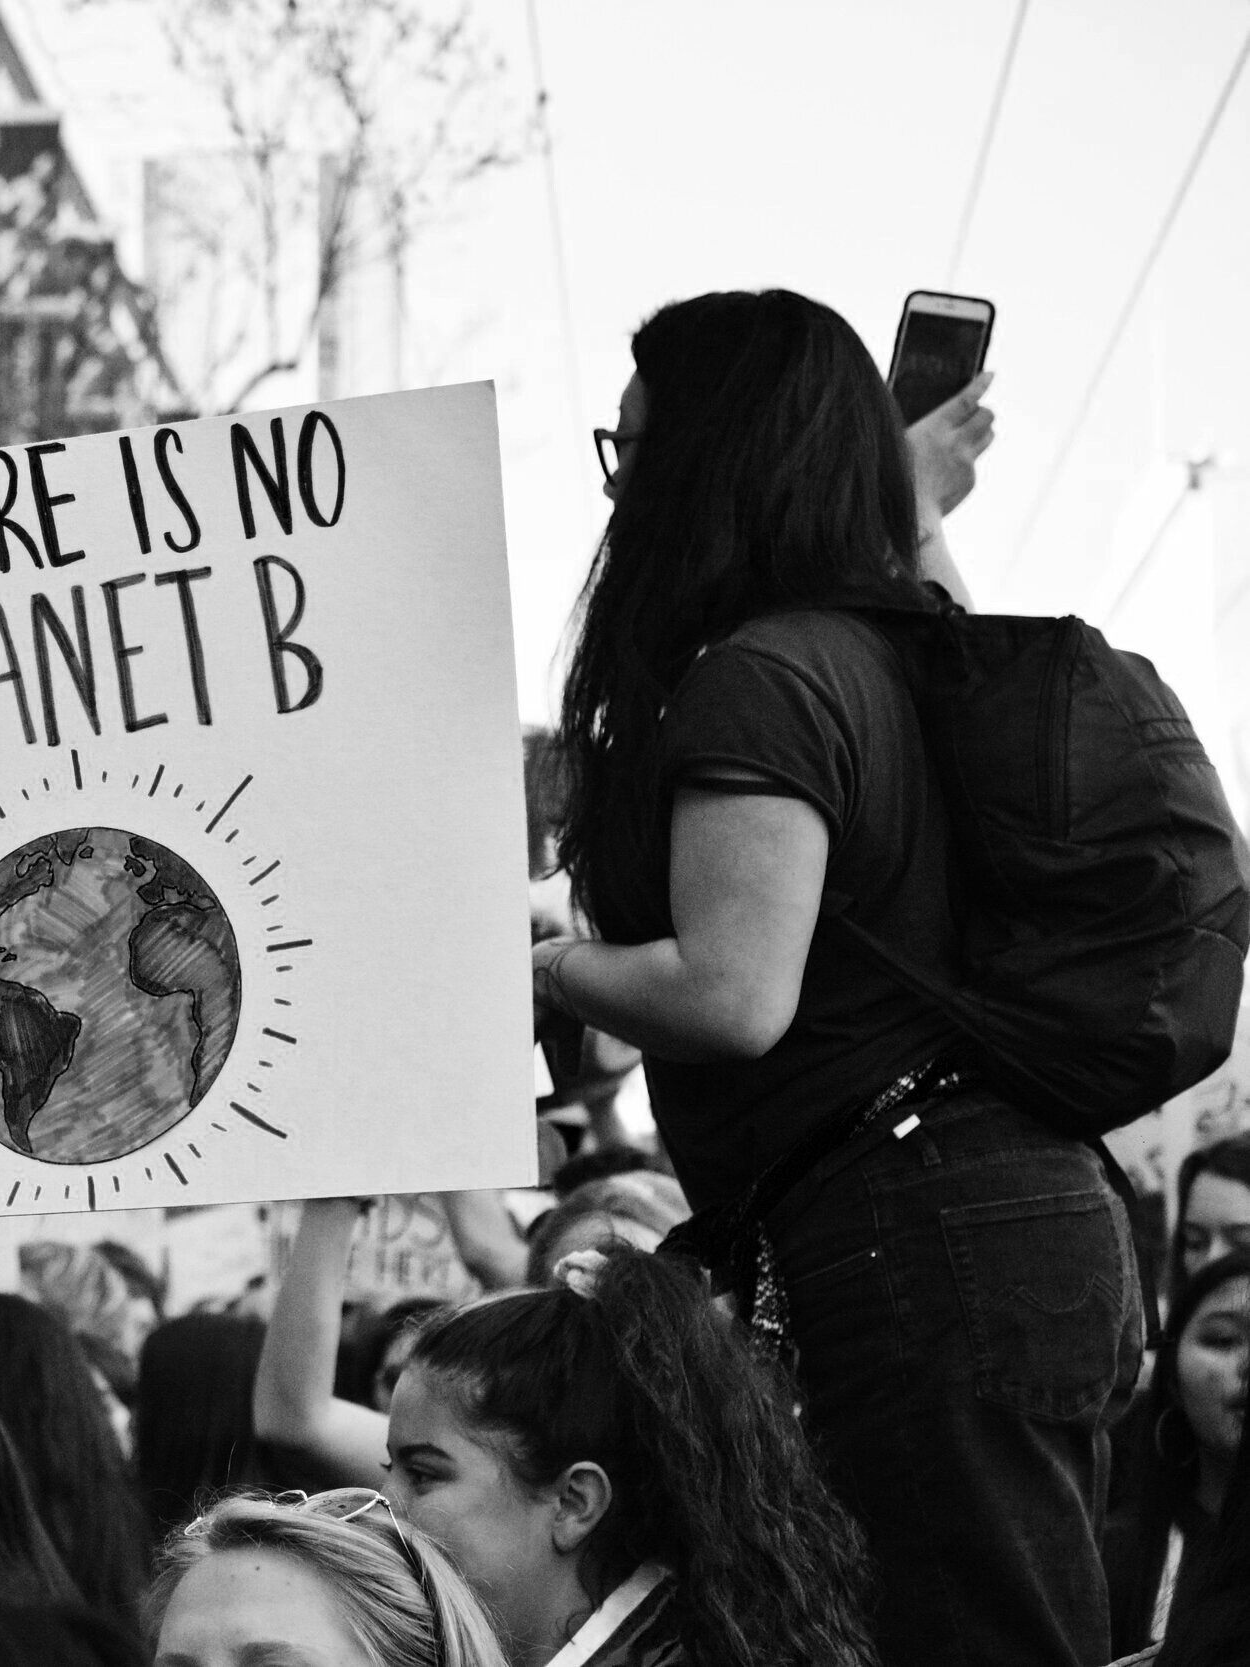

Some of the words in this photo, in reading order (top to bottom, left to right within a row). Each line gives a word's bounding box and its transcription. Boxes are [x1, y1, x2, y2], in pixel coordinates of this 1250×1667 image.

[119, 427, 202, 555] IS
[230, 410, 347, 541] NO
[253, 554, 324, 714] B
